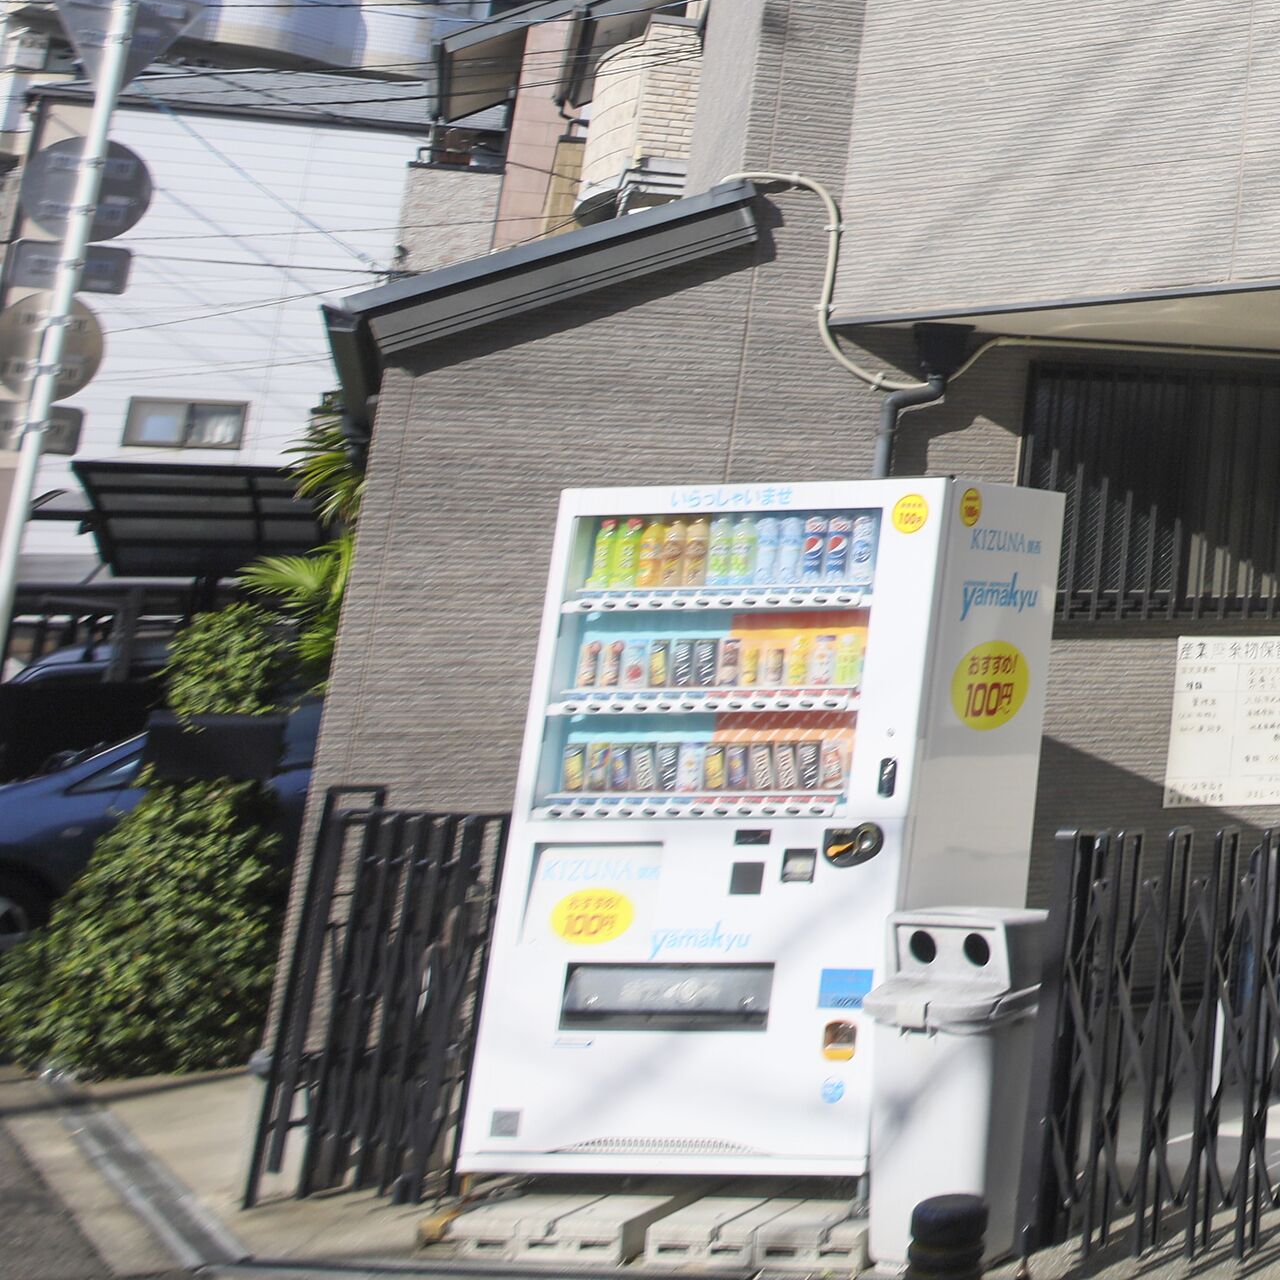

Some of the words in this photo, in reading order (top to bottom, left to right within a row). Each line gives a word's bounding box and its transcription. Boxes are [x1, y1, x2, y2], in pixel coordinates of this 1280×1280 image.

[670, 487, 793, 508] いらっしゃいませ
[970, 528, 1025, 553] KIZUNA
[960, 572, 1039, 621] yamakyu
[542, 858, 633, 881] KIZUNA
[648, 920, 752, 961] yamakyu
